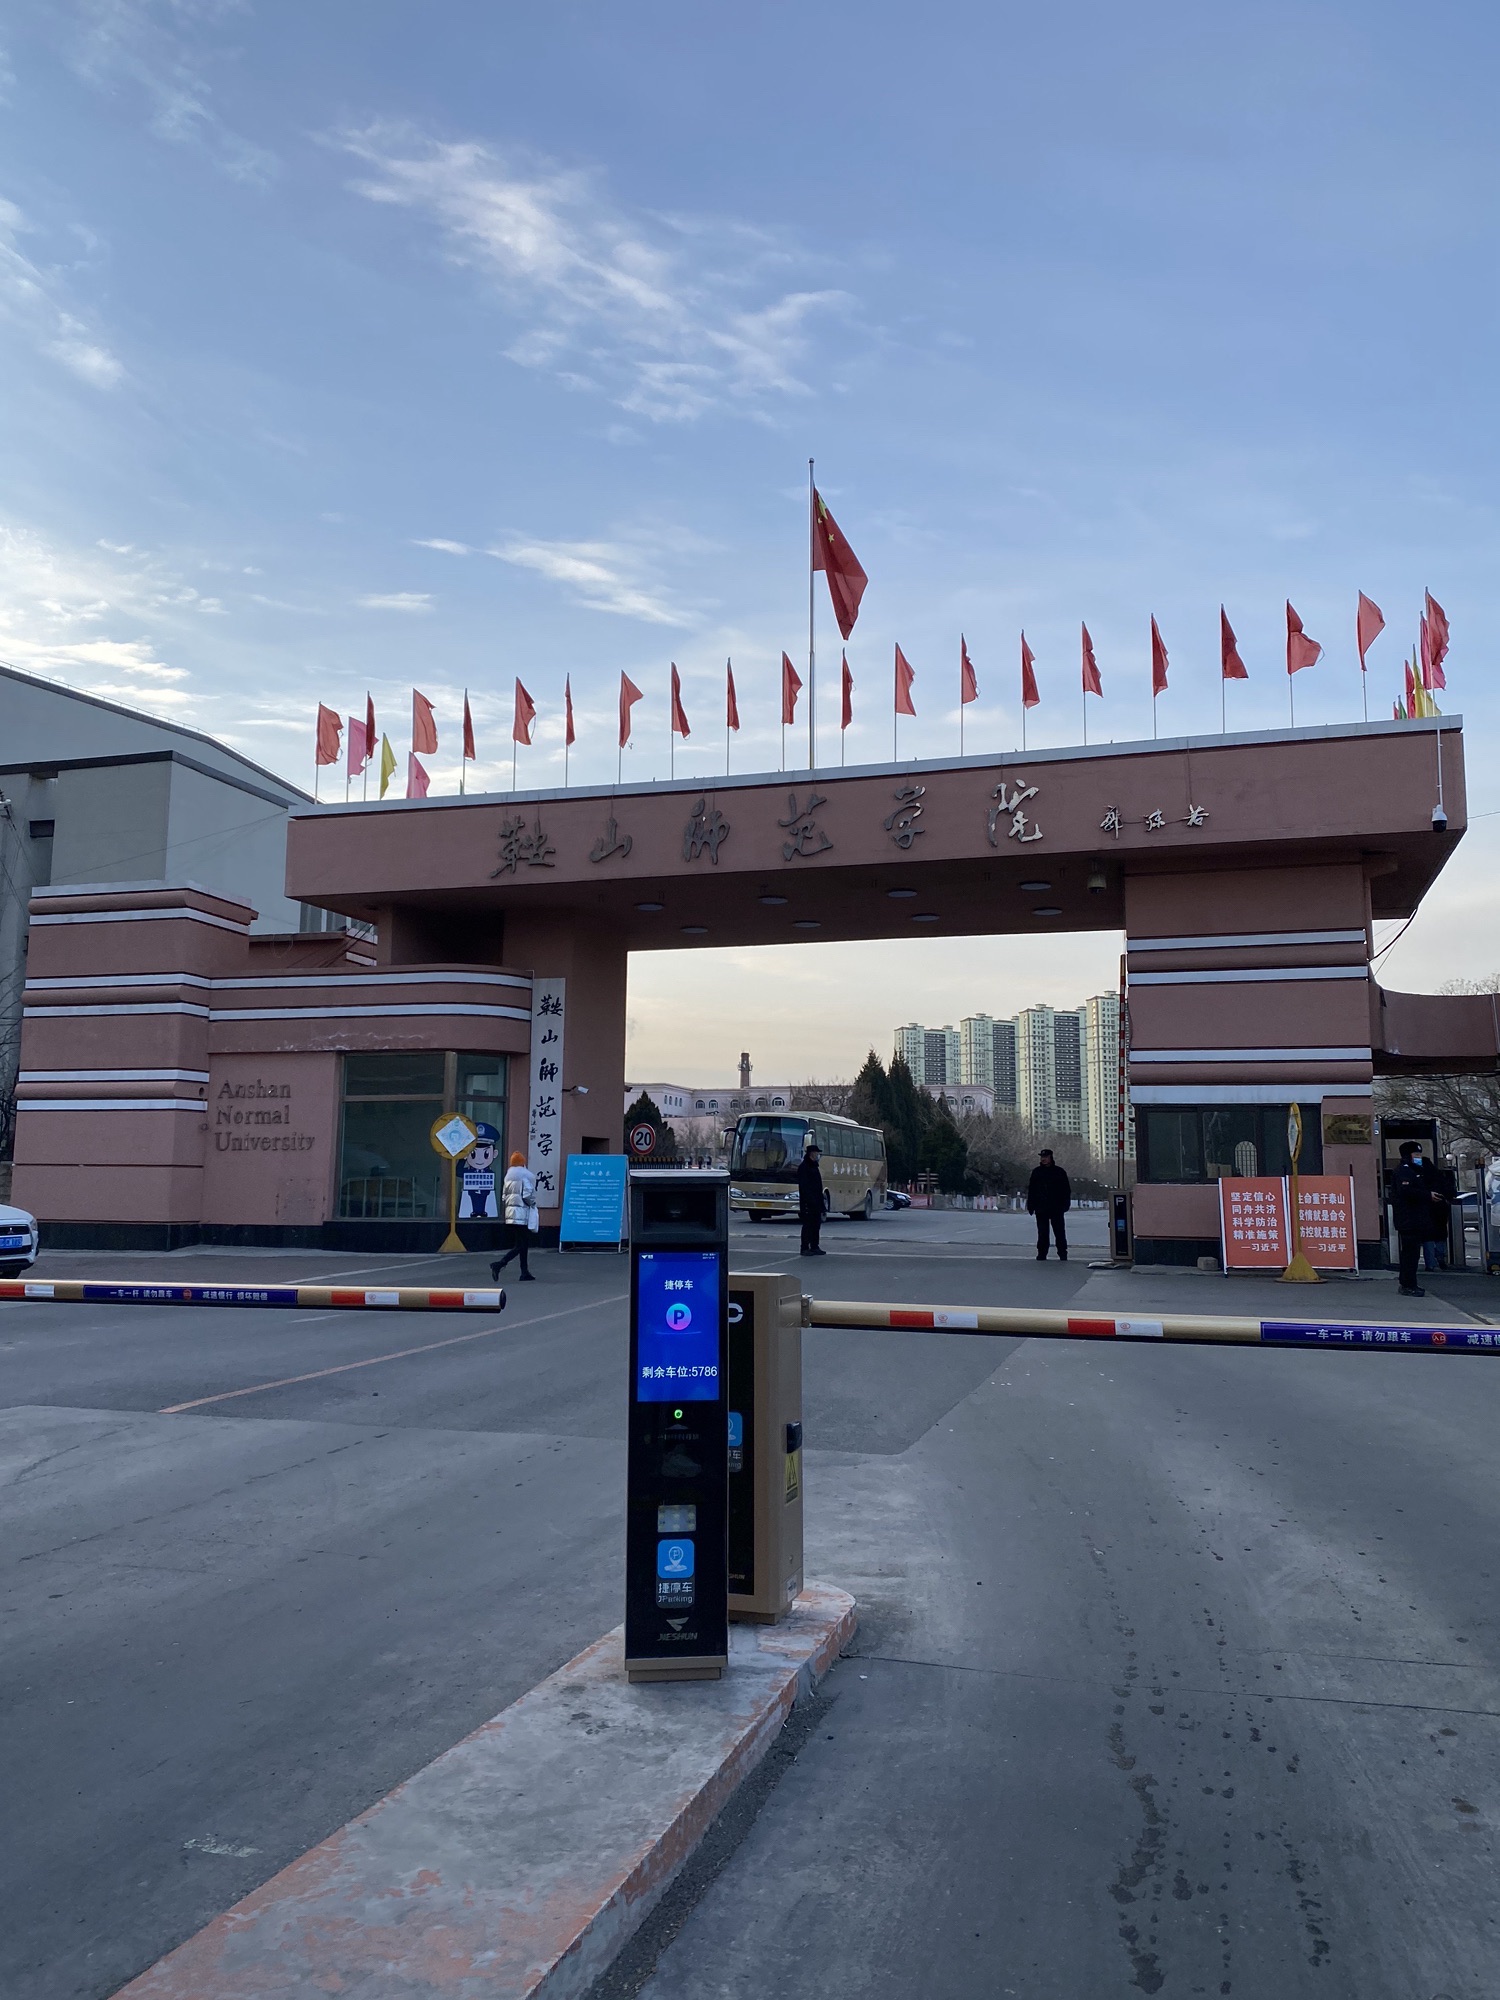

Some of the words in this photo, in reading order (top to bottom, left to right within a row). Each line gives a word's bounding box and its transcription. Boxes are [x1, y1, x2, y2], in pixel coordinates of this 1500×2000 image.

[217, 1079, 291, 1099] Anshan
[215, 1105, 291, 1125] Normal
[214, 1132, 316, 1152] University
[635, 1131, 652, 1147] 20
[1230, 1191, 1276, 1202] 坚定信心
[1231, 1204, 1277, 1215] 同舟共济
[1232, 1217, 1278, 1227] 科学防治
[1233, 1229, 1279, 1240] 精准施策
[664, 1279, 694, 1291] 捷停车
[1305, 1328, 1355, 1341] 一车一杆
[1361, 1330, 1412, 1343] 请勿跟车
[642, 1365, 718, 1379] 剩余车位:5786
[658, 1581, 693, 1594] 捷停车
